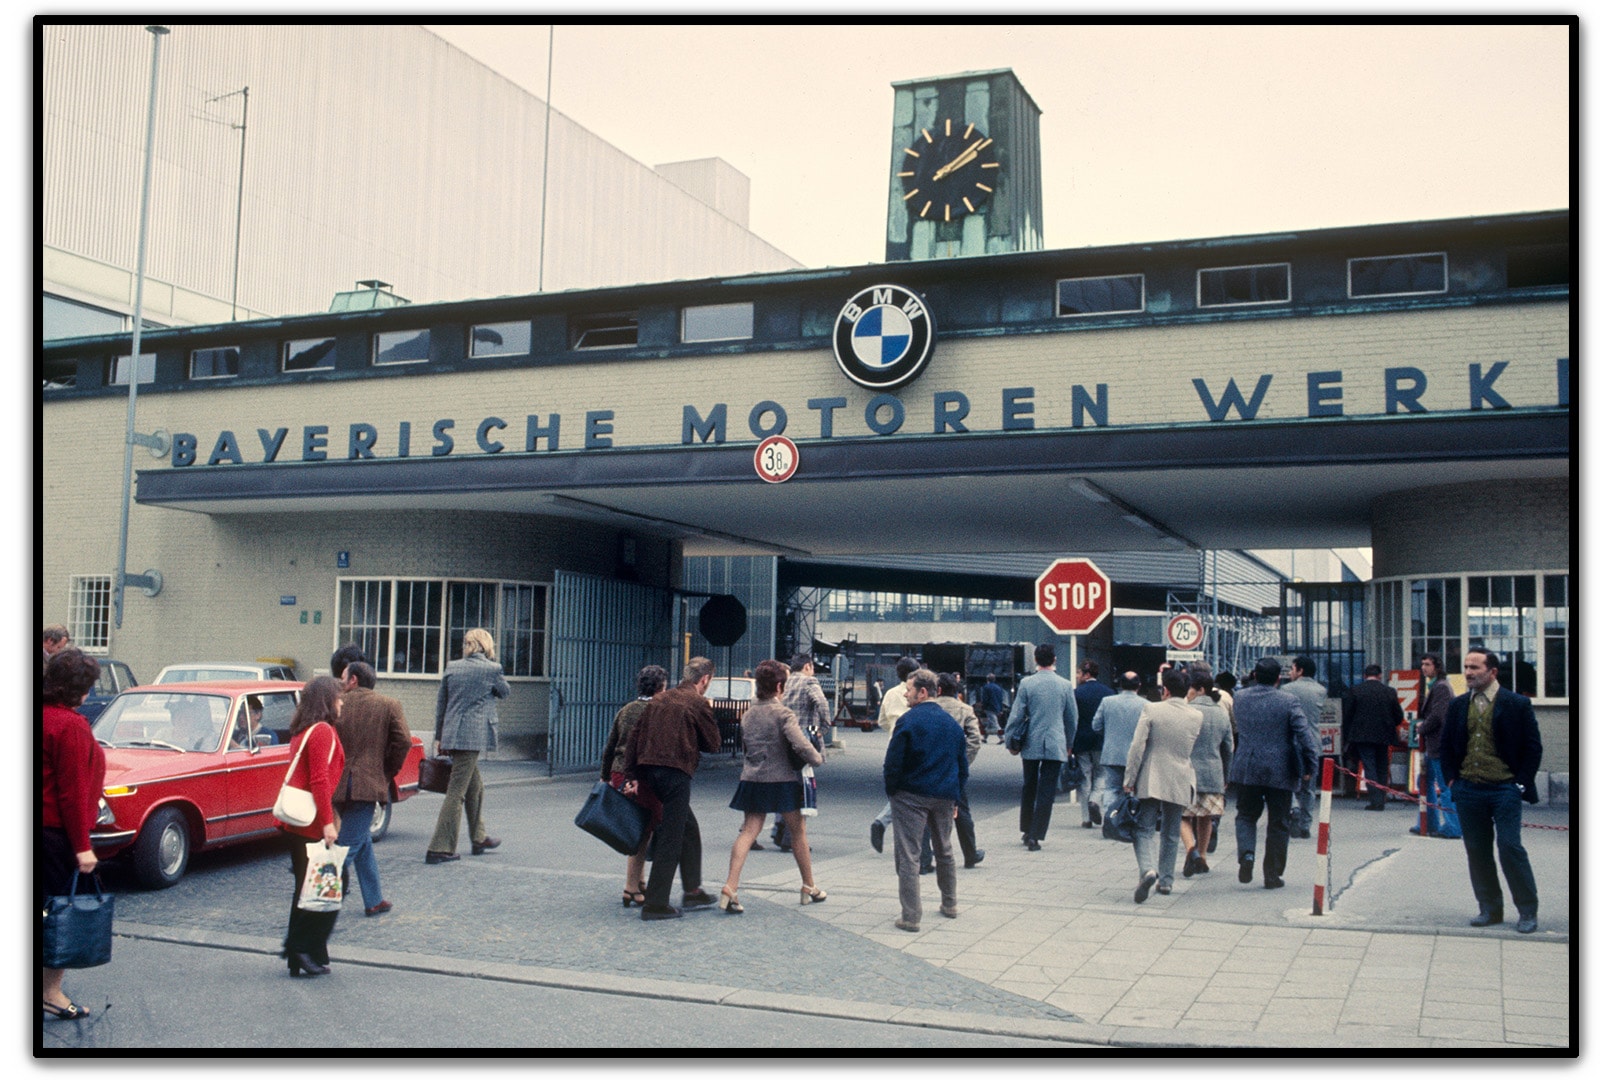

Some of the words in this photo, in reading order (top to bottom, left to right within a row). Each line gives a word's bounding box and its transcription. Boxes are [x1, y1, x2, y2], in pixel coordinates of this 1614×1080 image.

[843, 288, 923, 322] BMW
[171, 410, 615, 467] BAYERISCHE
[682, 383, 1108, 446] MOTOREN
[1044, 582, 1101, 610] STOP
[1176, 622, 1190, 641] 25
